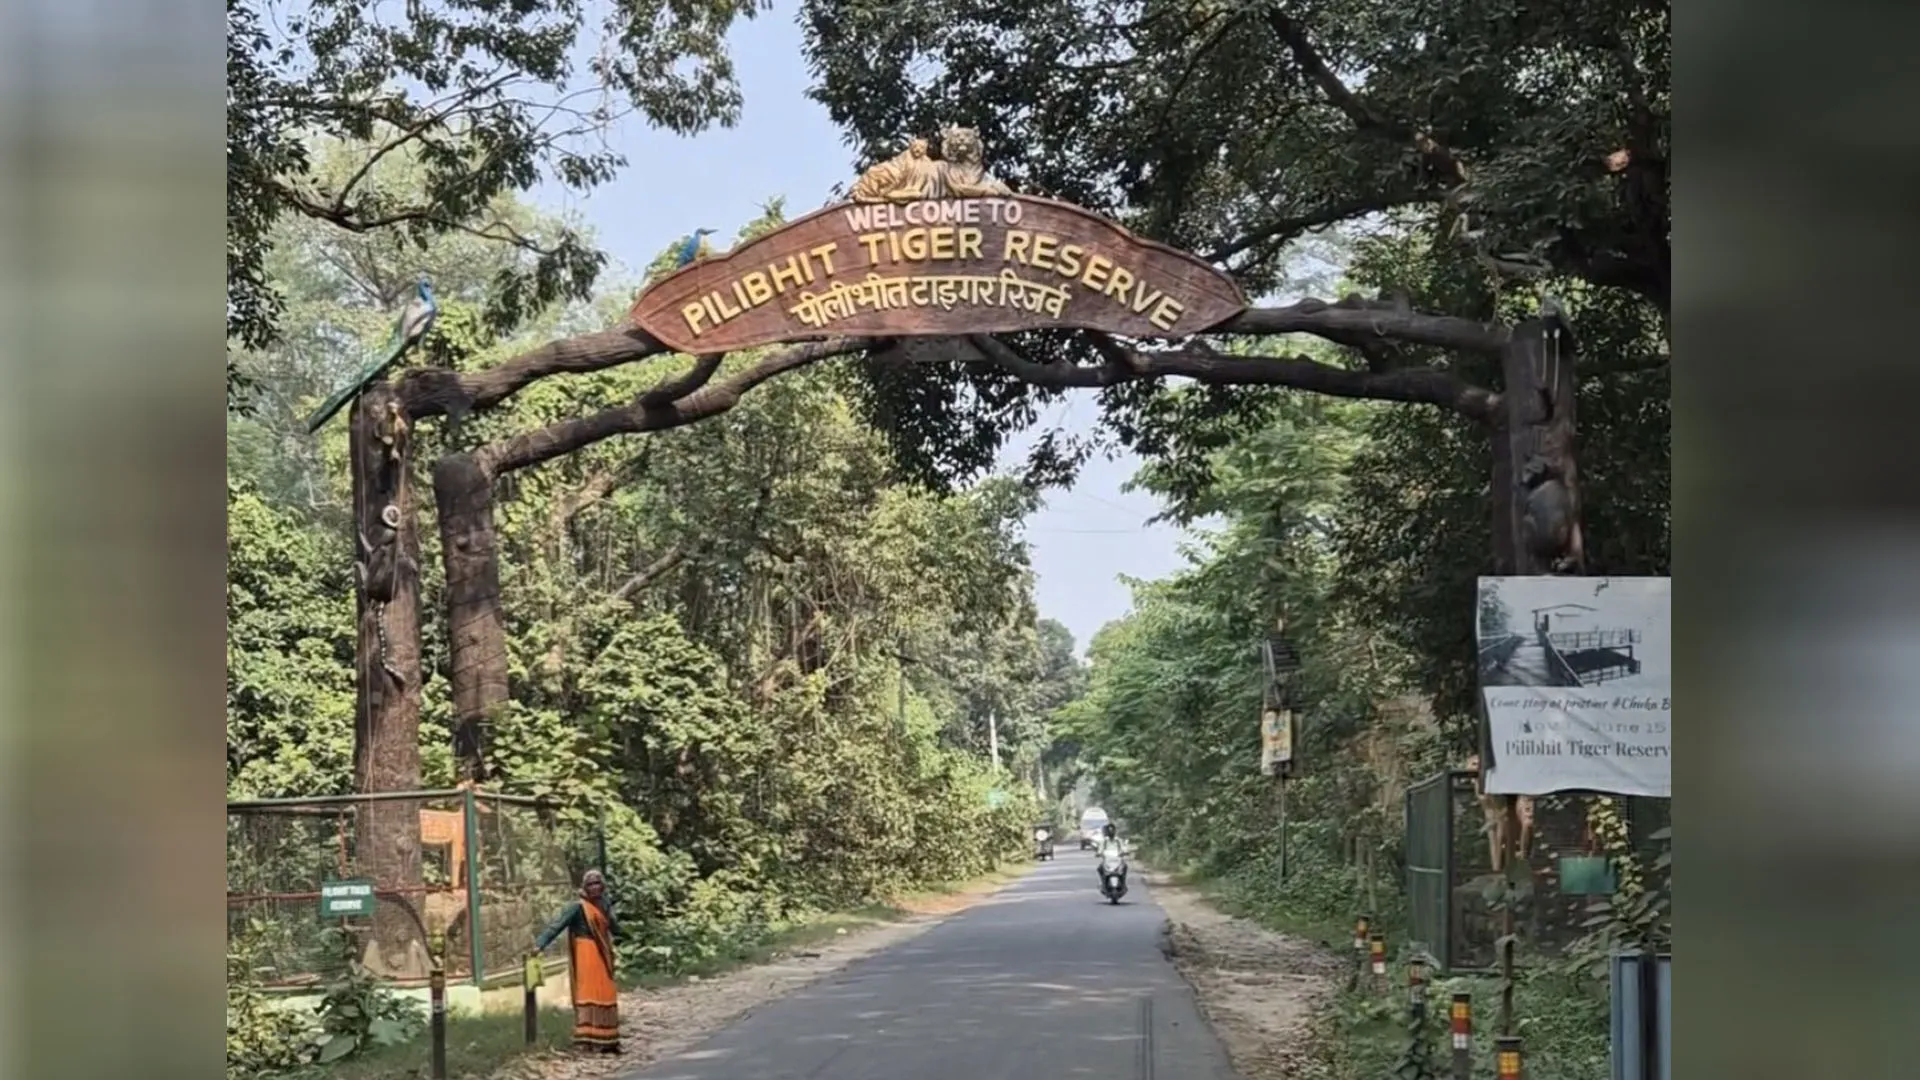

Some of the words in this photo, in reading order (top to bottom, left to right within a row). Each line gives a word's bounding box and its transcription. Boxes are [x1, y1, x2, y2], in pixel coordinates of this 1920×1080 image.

[845, 201, 981, 232] WELCOME
[990, 200, 1023, 226] TO
[681, 242, 838, 336] PILIBHIT
[858, 227, 984, 265] TIGER
[1003, 229, 1184, 332] RESERVE
[789, 272, 910, 328] पीलीभीत
[910, 275, 998, 313] टाइगर
[998, 266, 1072, 320] रिजर्व
[1505, 739, 1562, 757] Pilibhit
[1567, 739, 1611, 758] Tiger
